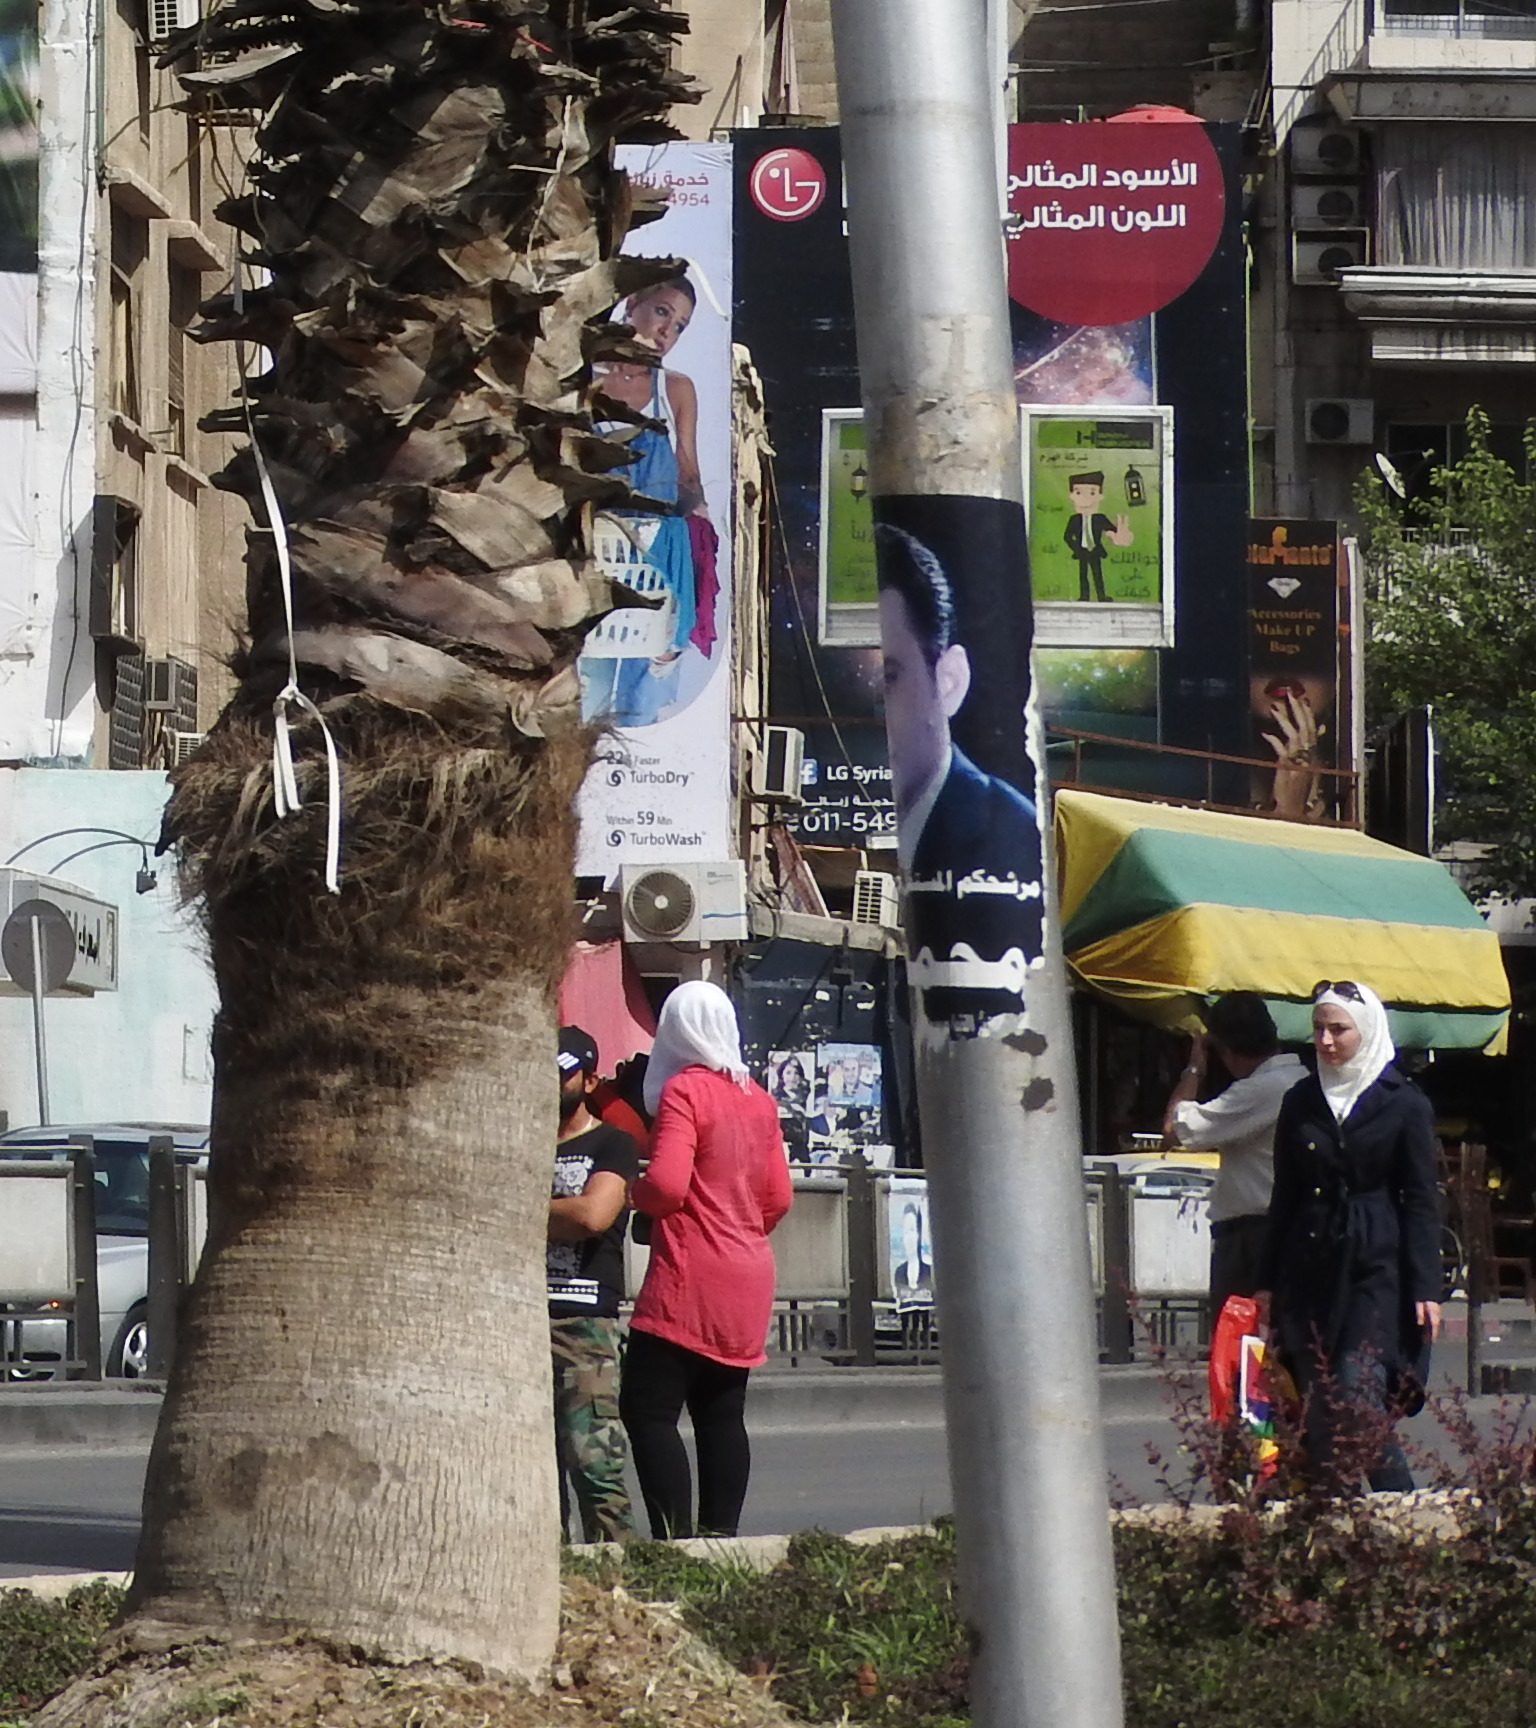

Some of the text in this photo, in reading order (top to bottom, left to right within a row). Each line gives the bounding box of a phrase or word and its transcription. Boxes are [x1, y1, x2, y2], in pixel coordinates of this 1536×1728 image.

[754, 152, 821, 217] LG
[1102, 158, 1197, 191] الأسود
[1111, 204, 1186, 233] اللون
[827, 765, 848, 780] LG
[853, 765, 893, 785] Syria
[637, 811, 655, 825] 59
